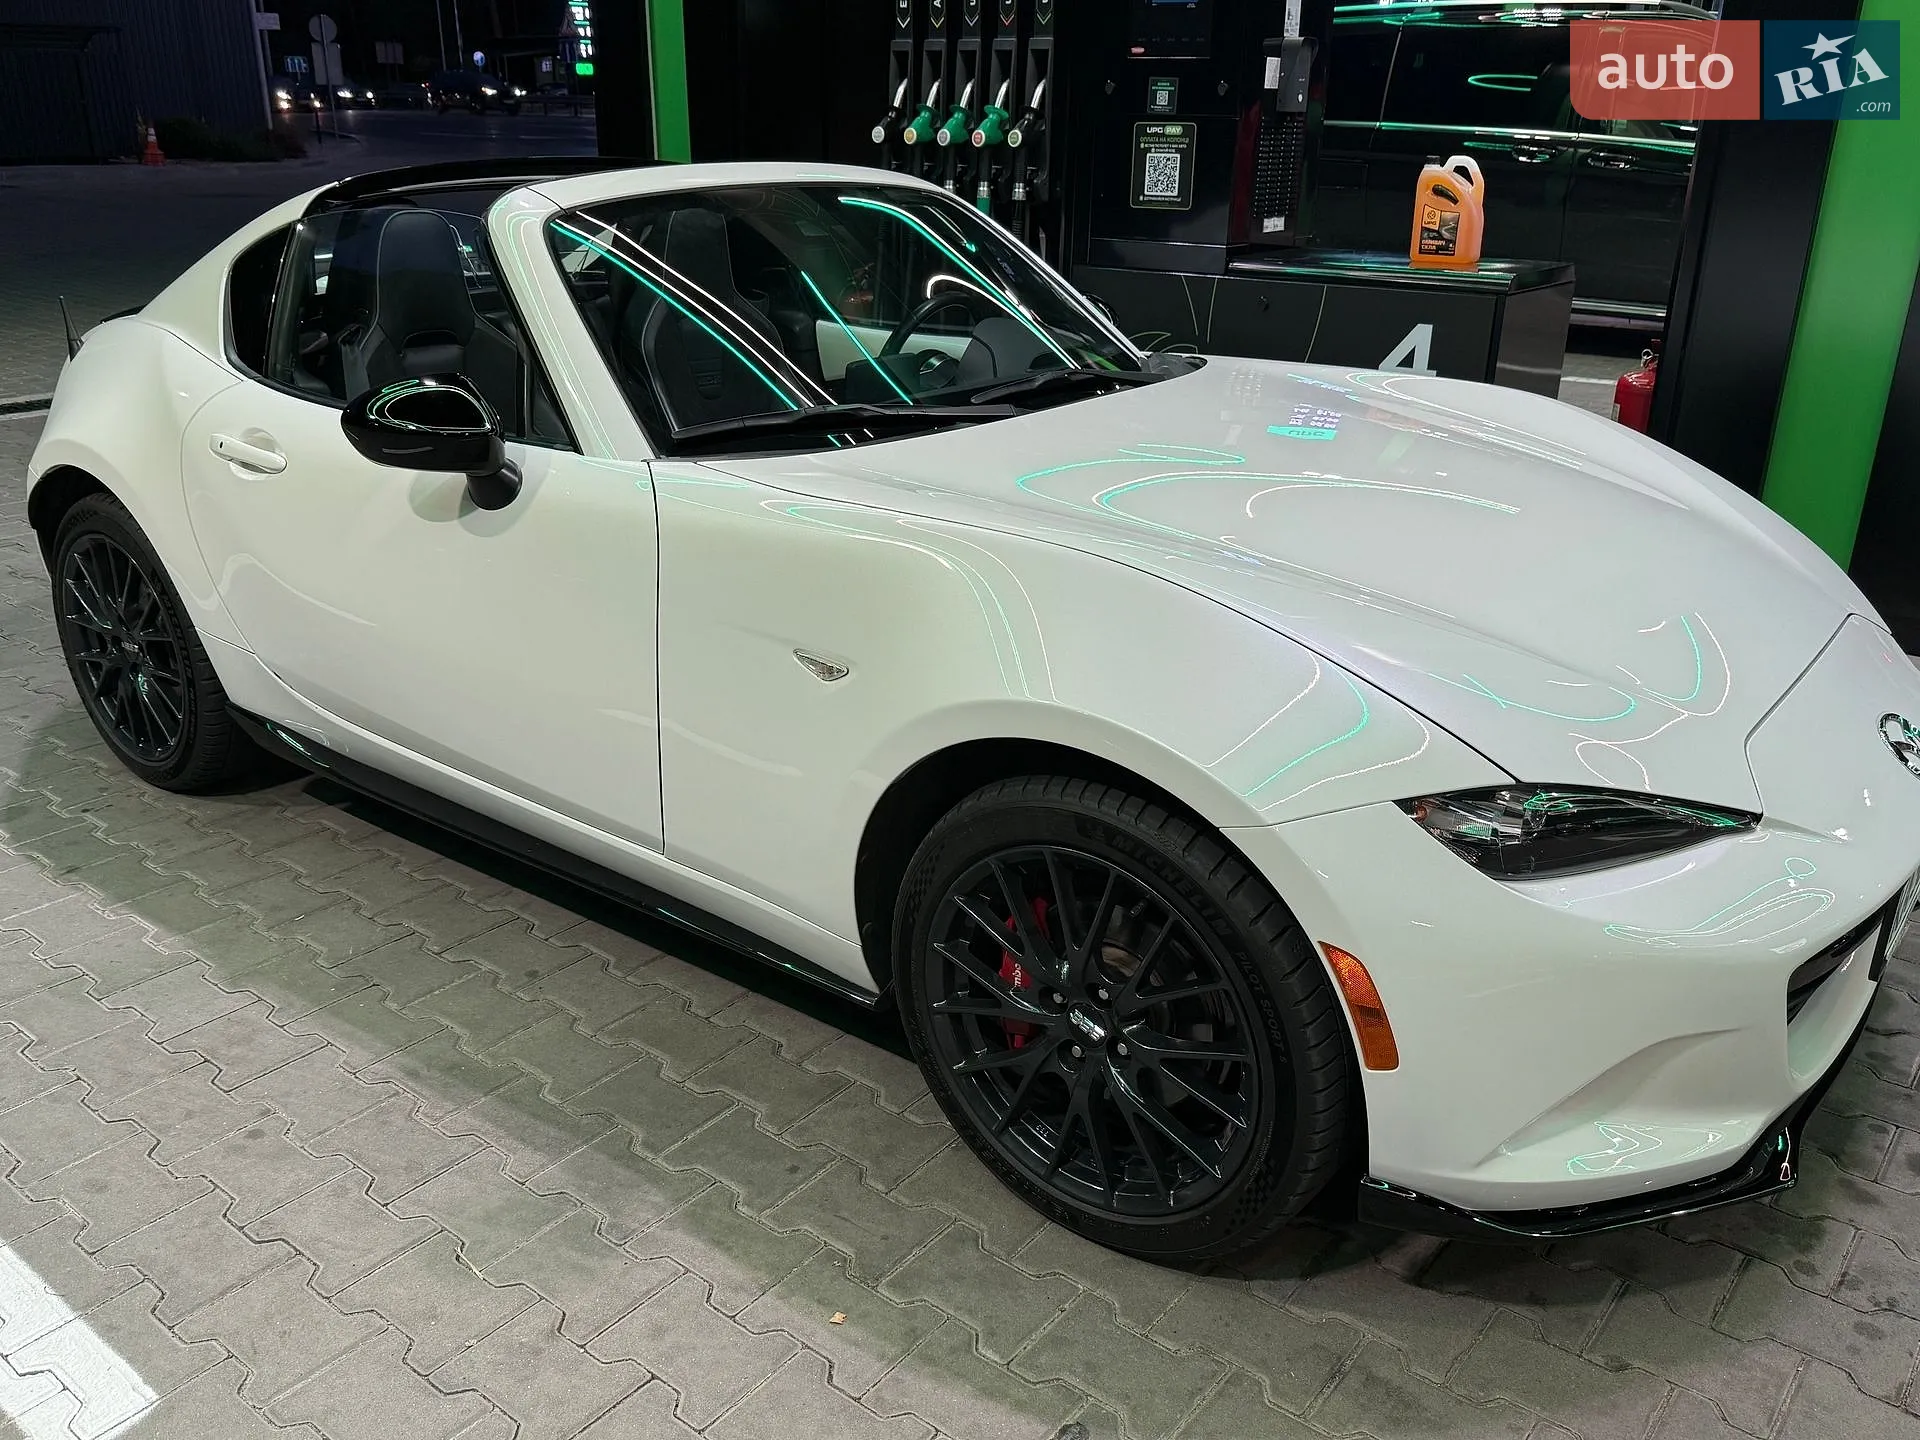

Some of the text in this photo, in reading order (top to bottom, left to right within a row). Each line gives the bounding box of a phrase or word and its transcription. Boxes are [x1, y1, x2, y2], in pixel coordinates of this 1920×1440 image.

[1146, 126, 1181, 134] UPG PAY
[1378, 323, 1437, 377] 4
[1012, 962, 1022, 987] mbo
[1234, 951, 1266, 994] PILOT
[1259, 998, 1286, 1053] SPORT
